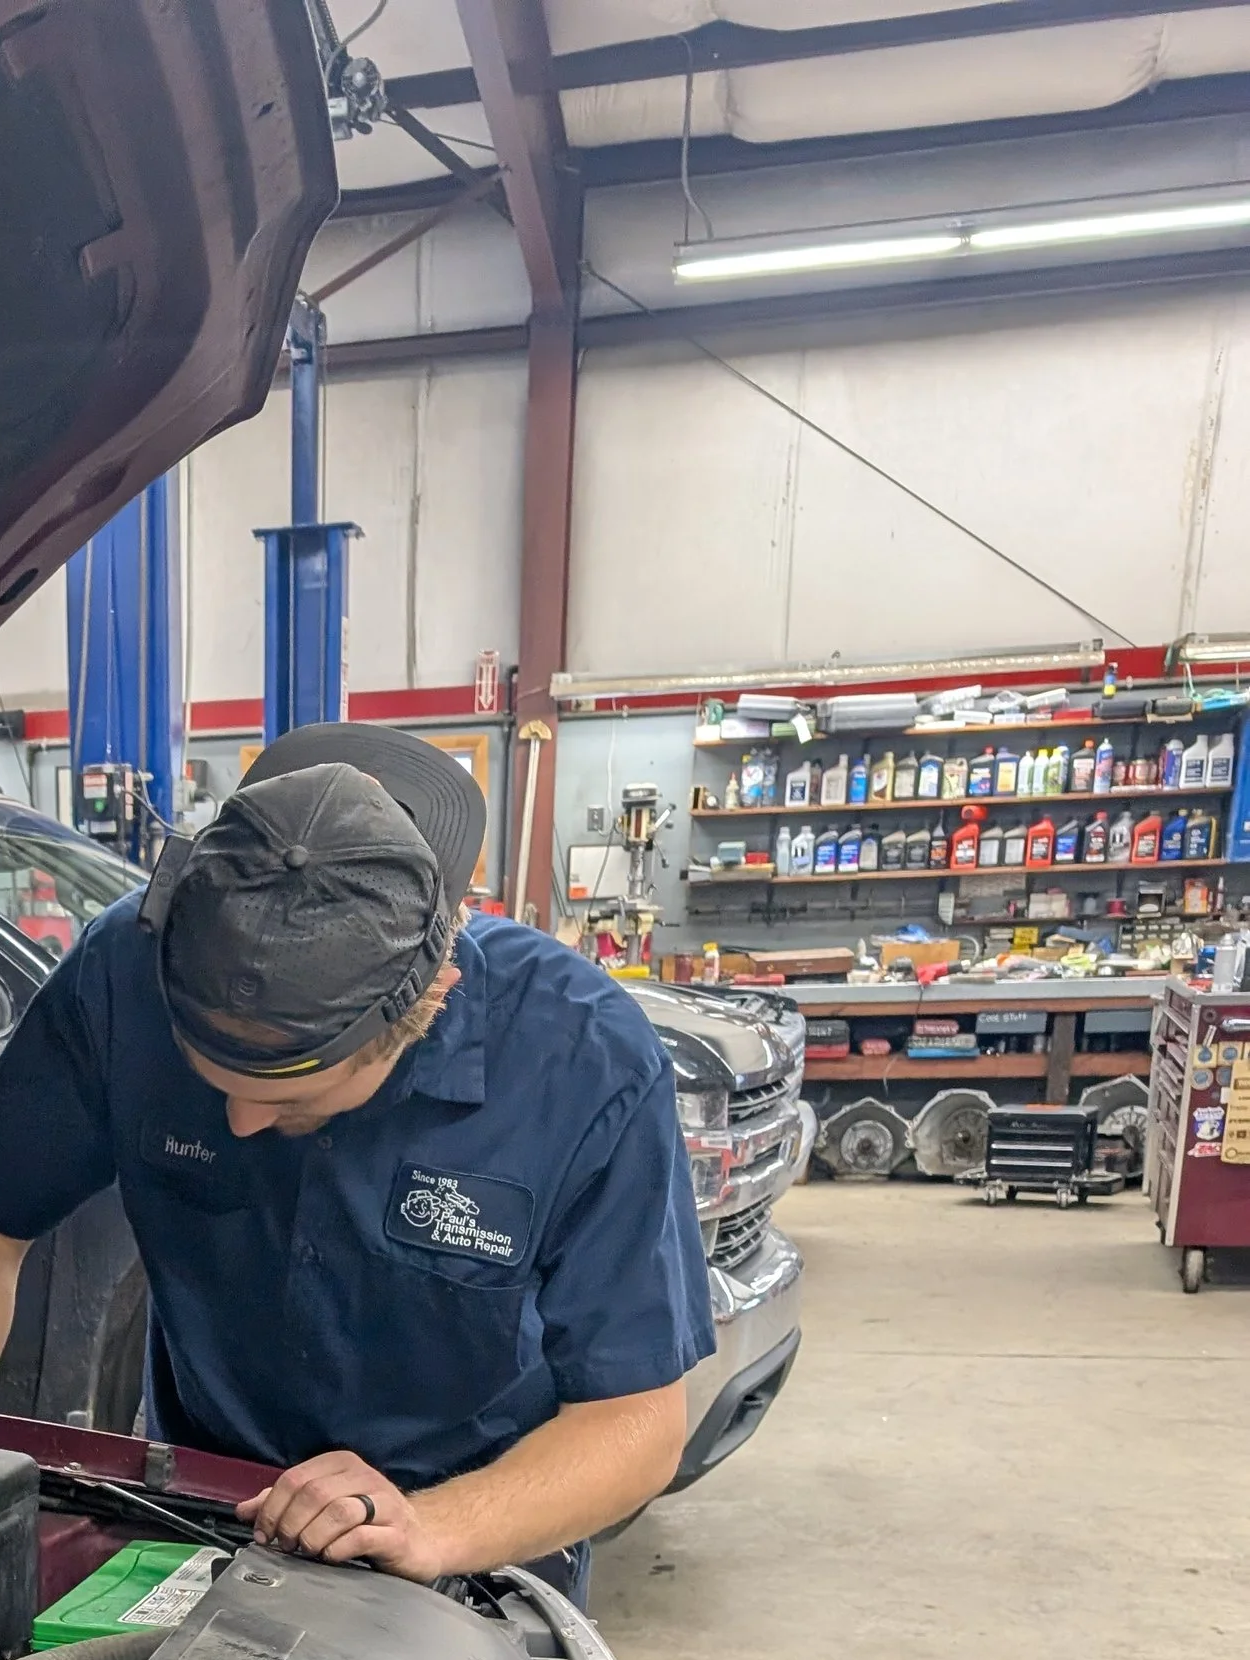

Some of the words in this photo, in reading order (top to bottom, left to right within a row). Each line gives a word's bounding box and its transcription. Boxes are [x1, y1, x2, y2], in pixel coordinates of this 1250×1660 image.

[164, 1135, 218, 1164] Hunter
[412, 1169, 436, 1185] Since
[437, 1176, 459, 1189] 1983
[435, 1219, 512, 1245] Transmission
[441, 1211, 476, 1228] Paul's
[431, 1230, 441, 1241] &
[442, 1234, 472, 1248] Auto
[474, 1239, 514, 1258] Repair
